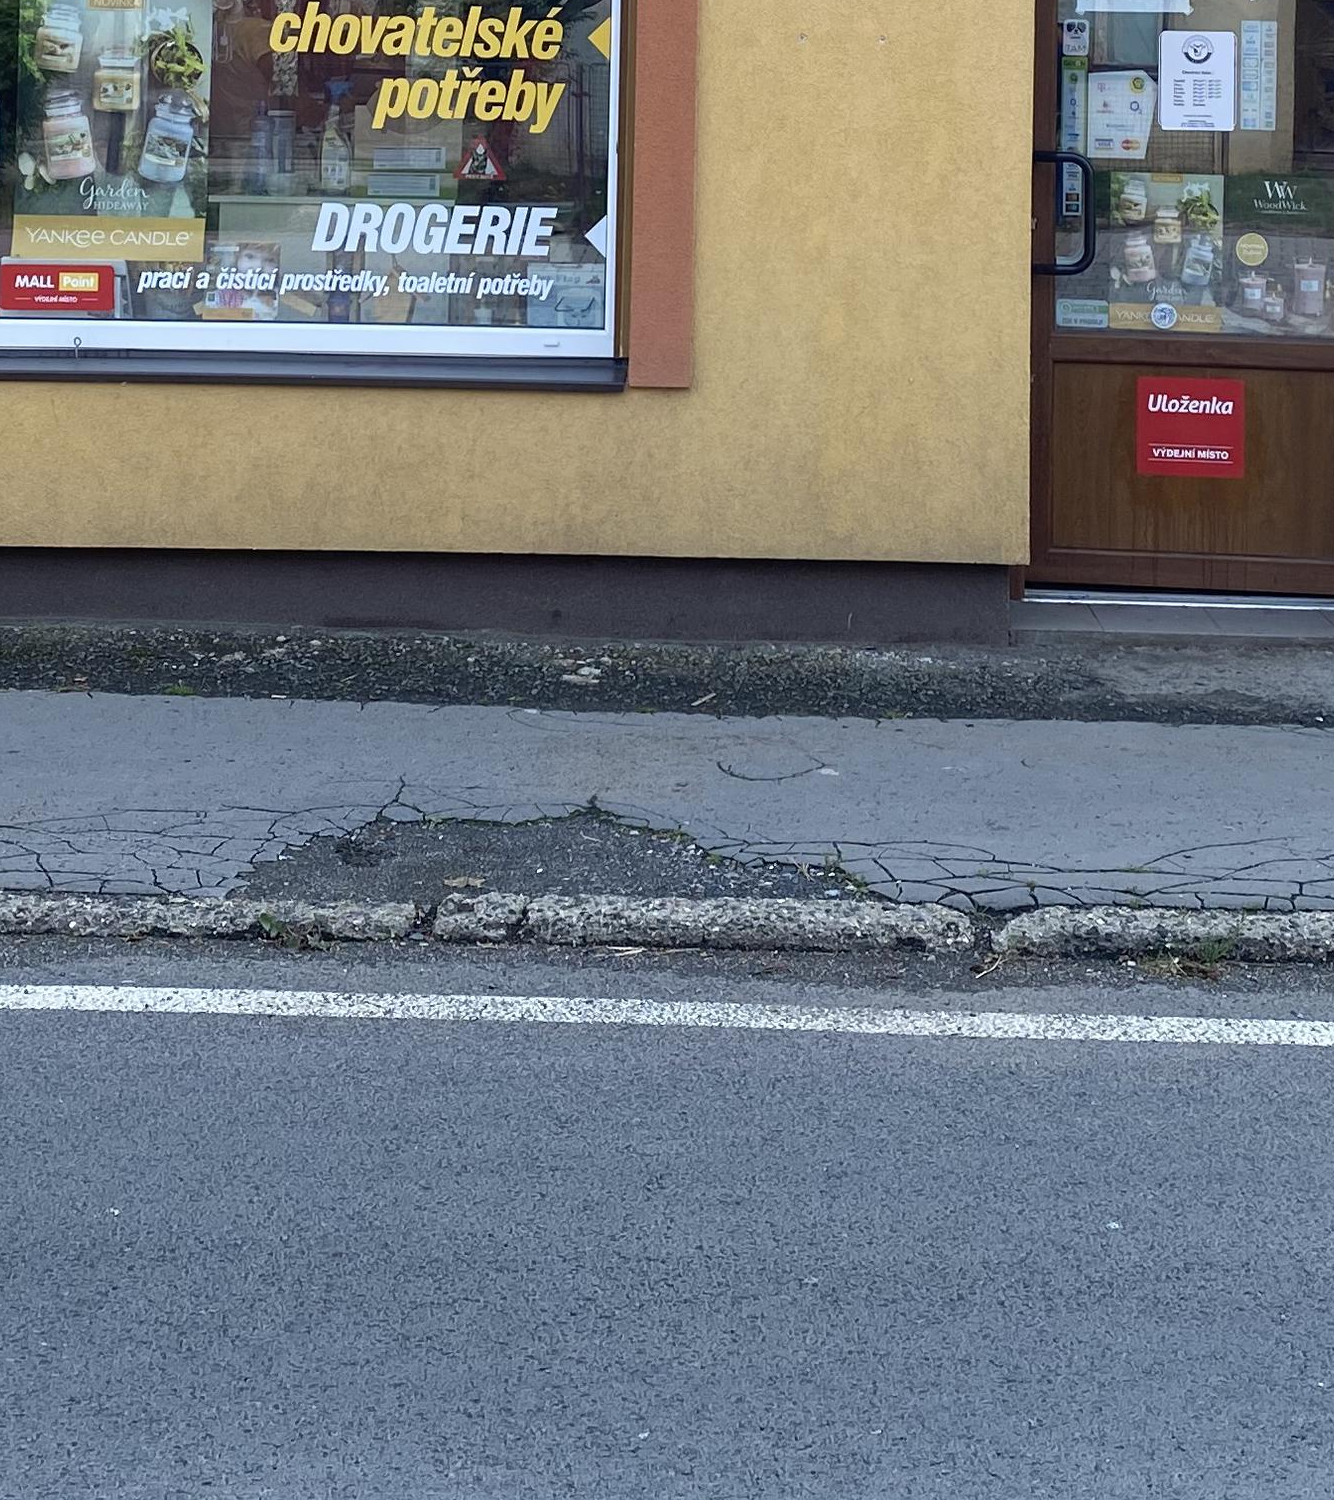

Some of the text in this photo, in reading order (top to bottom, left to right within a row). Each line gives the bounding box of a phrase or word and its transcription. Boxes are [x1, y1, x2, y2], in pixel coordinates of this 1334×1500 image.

[268, 1, 564, 60] chovatelské
[371, 67, 566, 134] potřeby
[79, 175, 150, 210] Garden
[92, 200, 150, 211] HIDEAWAY
[311, 202, 559, 257] DROGERIE
[14, 275, 96, 289] MALL Point
[136, 265, 193, 294] prací
[195, 273, 209, 290] a
[216, 267, 276, 291] čistící
[279, 269, 391, 297] prostředky,
[396, 271, 474, 295] toaletní
[475, 273, 555, 301] potřeby
[1148, 394, 1234, 415] Uloženka
[1152, 446, 1229, 460] VÝDEJNÍ MÍSTO
